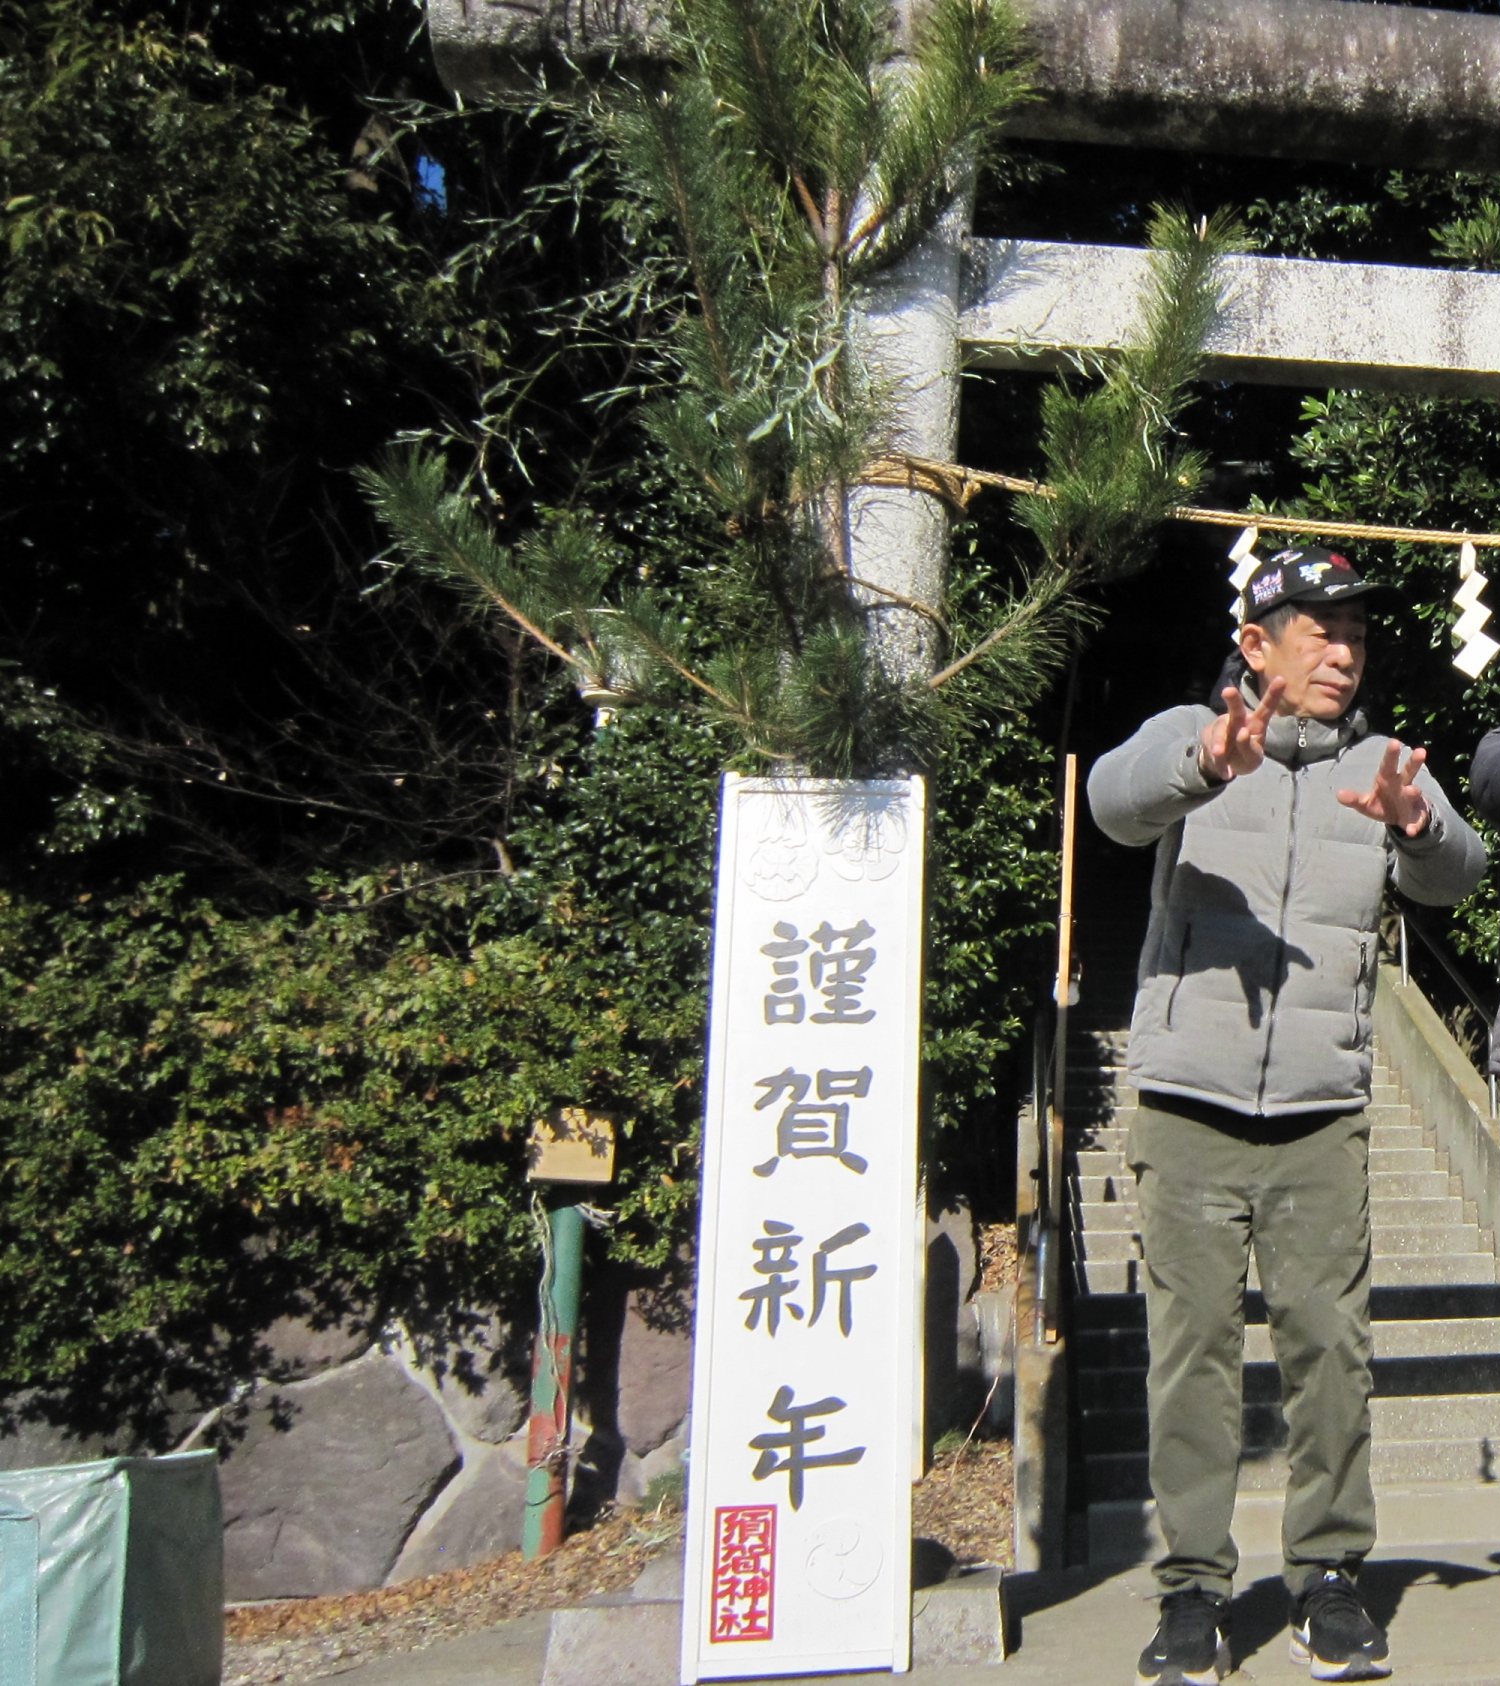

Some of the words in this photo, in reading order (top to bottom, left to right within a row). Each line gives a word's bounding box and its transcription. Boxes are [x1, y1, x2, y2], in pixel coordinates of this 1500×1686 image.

[738, 919, 878, 1513] 謹賀新年
[715, 1510, 773, 1636] 須賀神社
